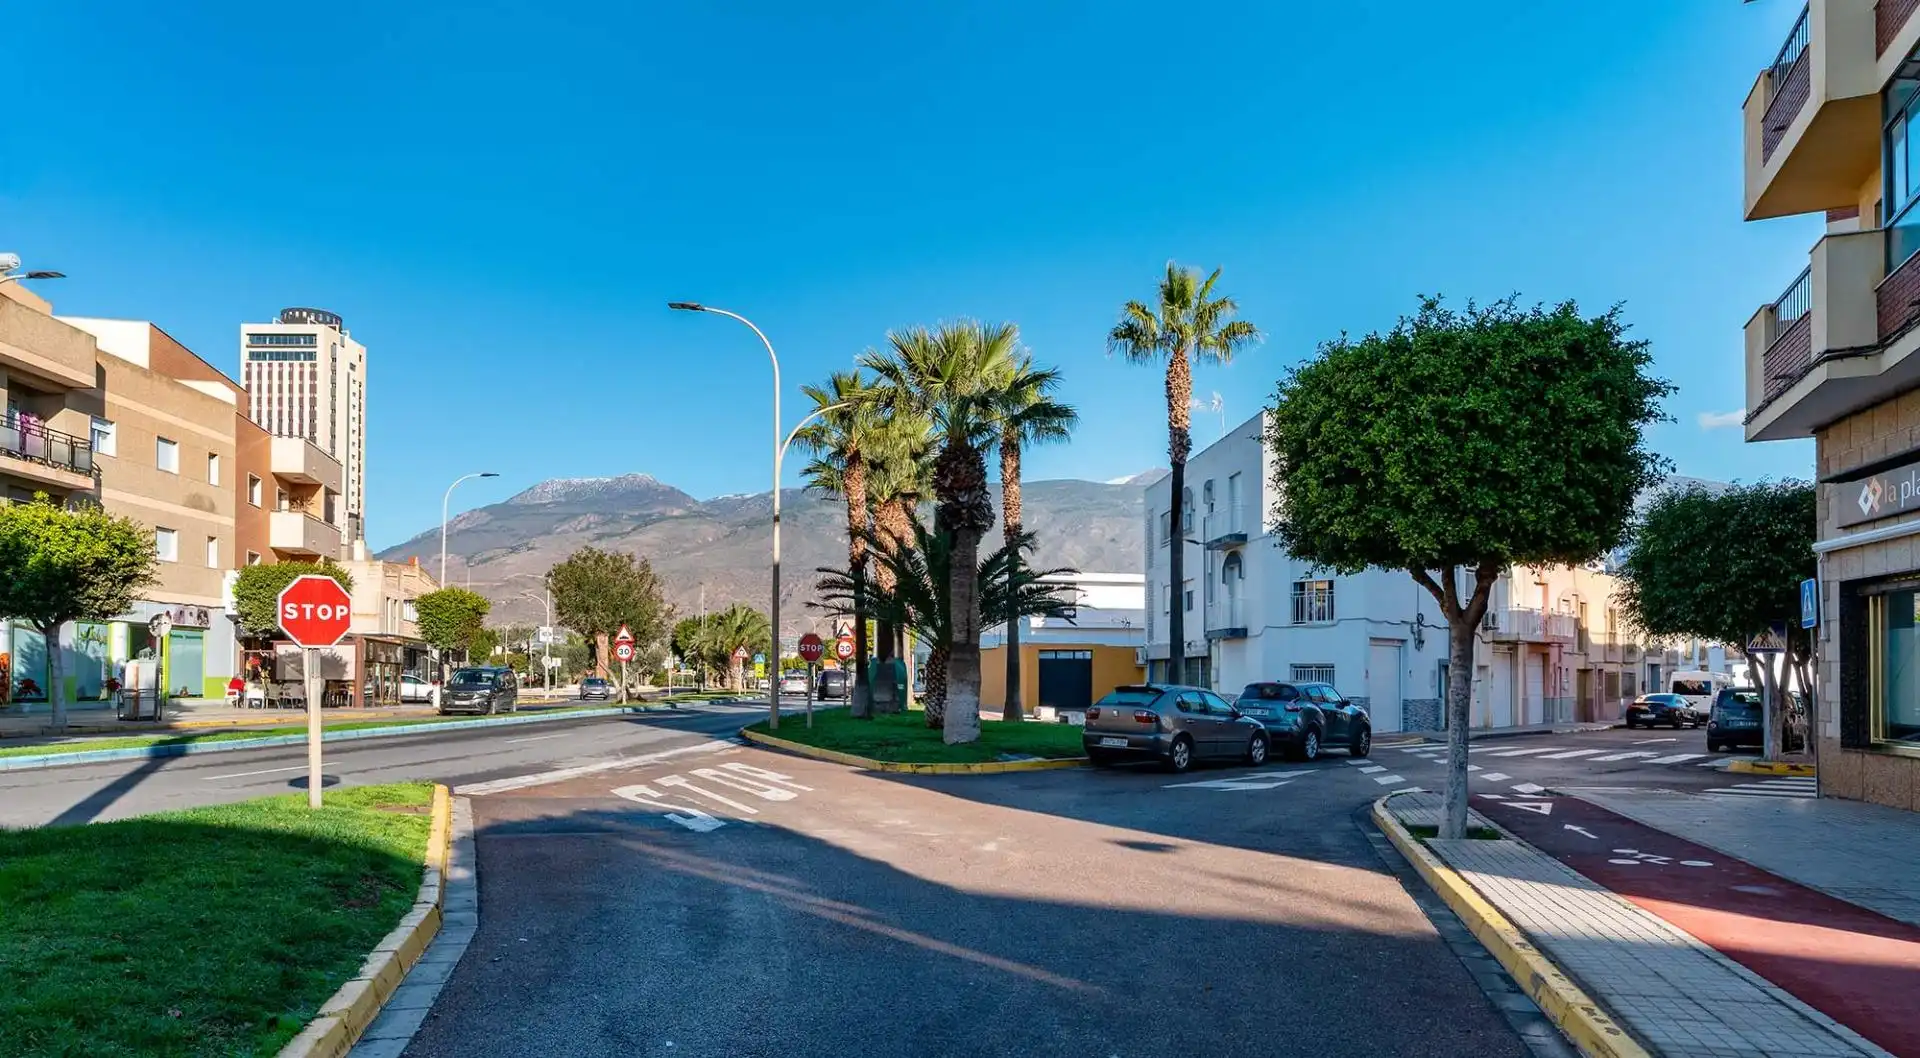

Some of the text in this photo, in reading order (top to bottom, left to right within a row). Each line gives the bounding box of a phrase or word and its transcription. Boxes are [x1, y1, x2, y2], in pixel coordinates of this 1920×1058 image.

[1884, 479, 1897, 503] la
[283, 602, 349, 621] STOP
[618, 648, 630, 656] 30
[800, 644, 824, 652] STOP
[610, 761, 815, 833] STOP
